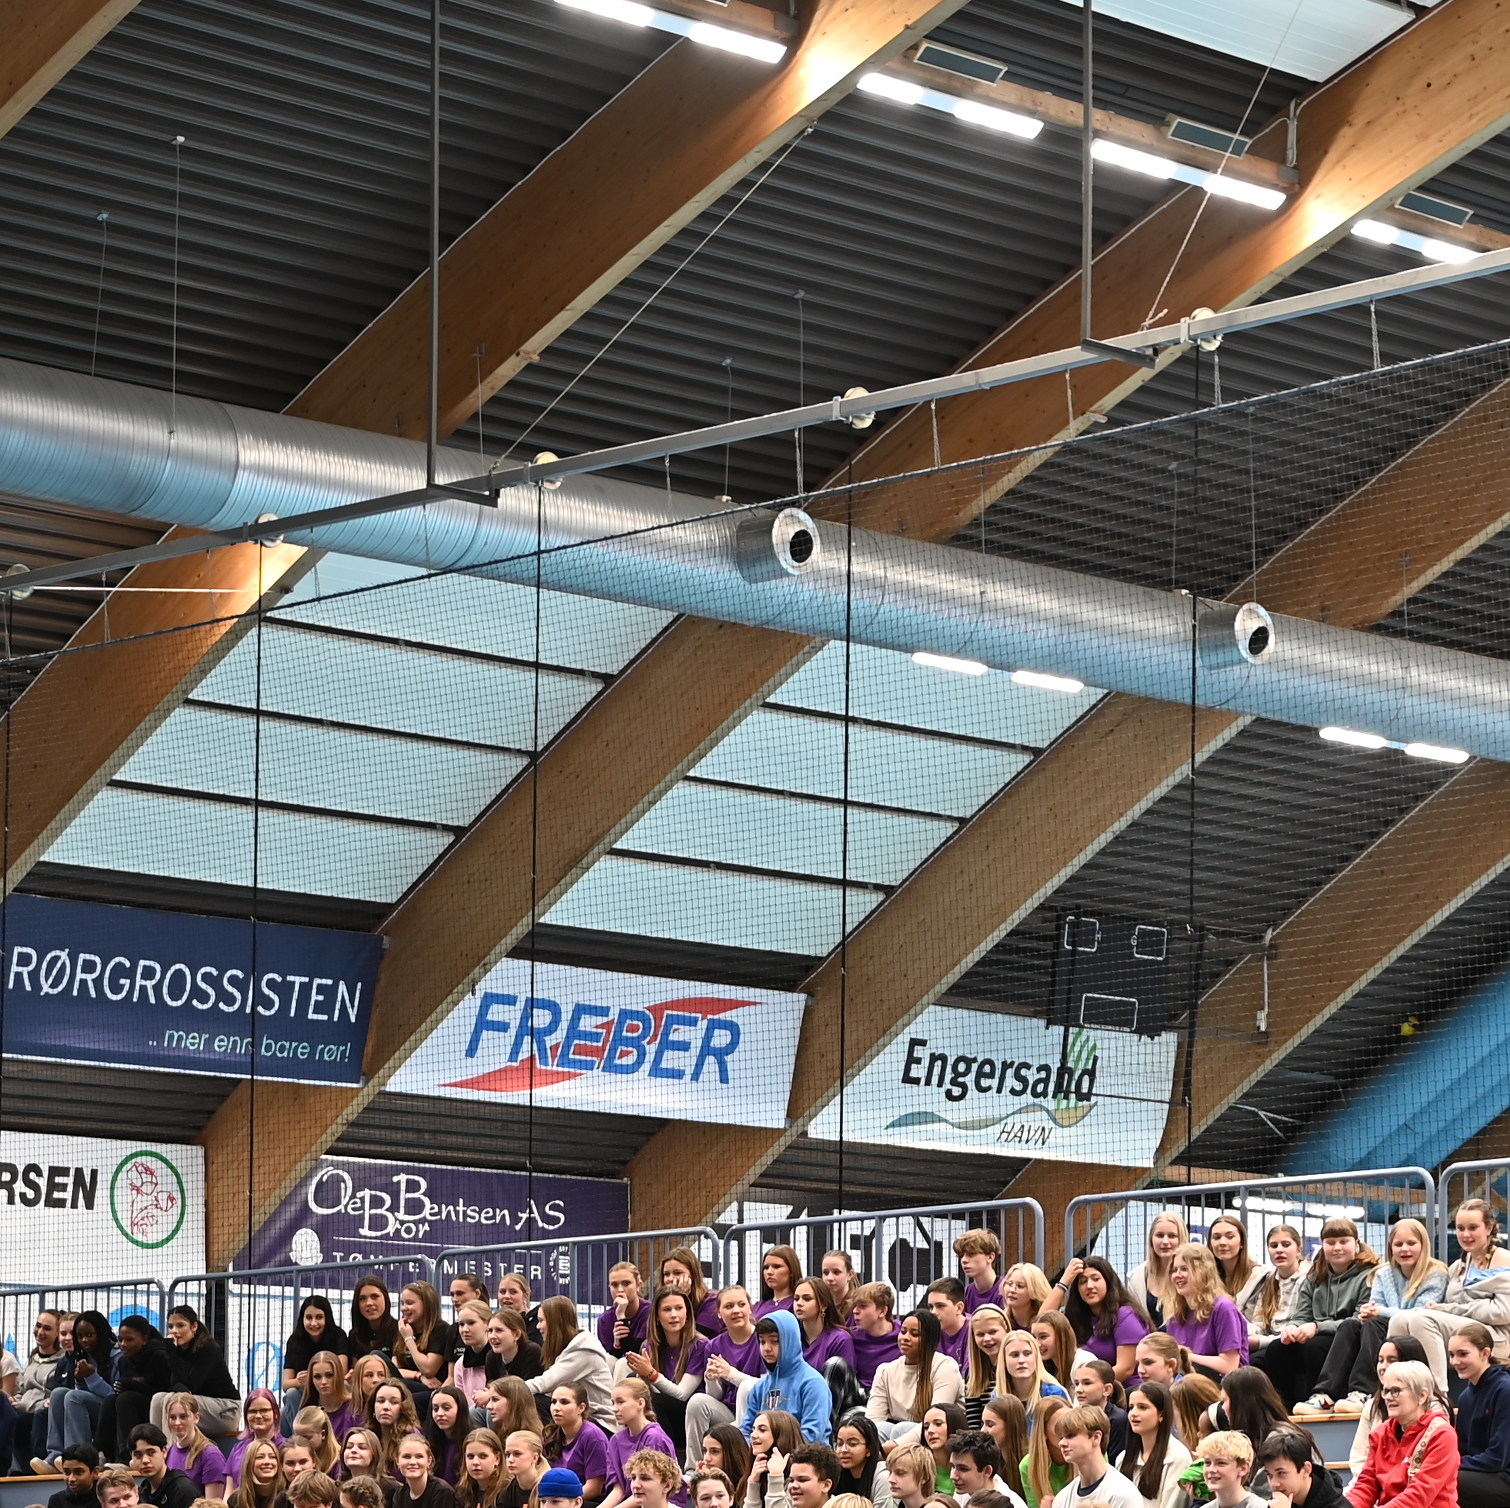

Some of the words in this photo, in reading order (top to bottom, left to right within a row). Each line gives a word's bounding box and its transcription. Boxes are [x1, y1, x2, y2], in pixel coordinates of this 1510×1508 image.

[7, 945, 363, 1024] RØRGROSSISTEN
[164, 1029, 209, 1051] mer
[261, 1033, 309, 1060] bare
[463, 991, 742, 1085] FREBER
[901, 1037, 1099, 1102] Engersand
[996, 1121, 1053, 1147] HAVN
[392, 1173, 511, 1227] Bentsen
[514, 1197, 566, 1231] AS
